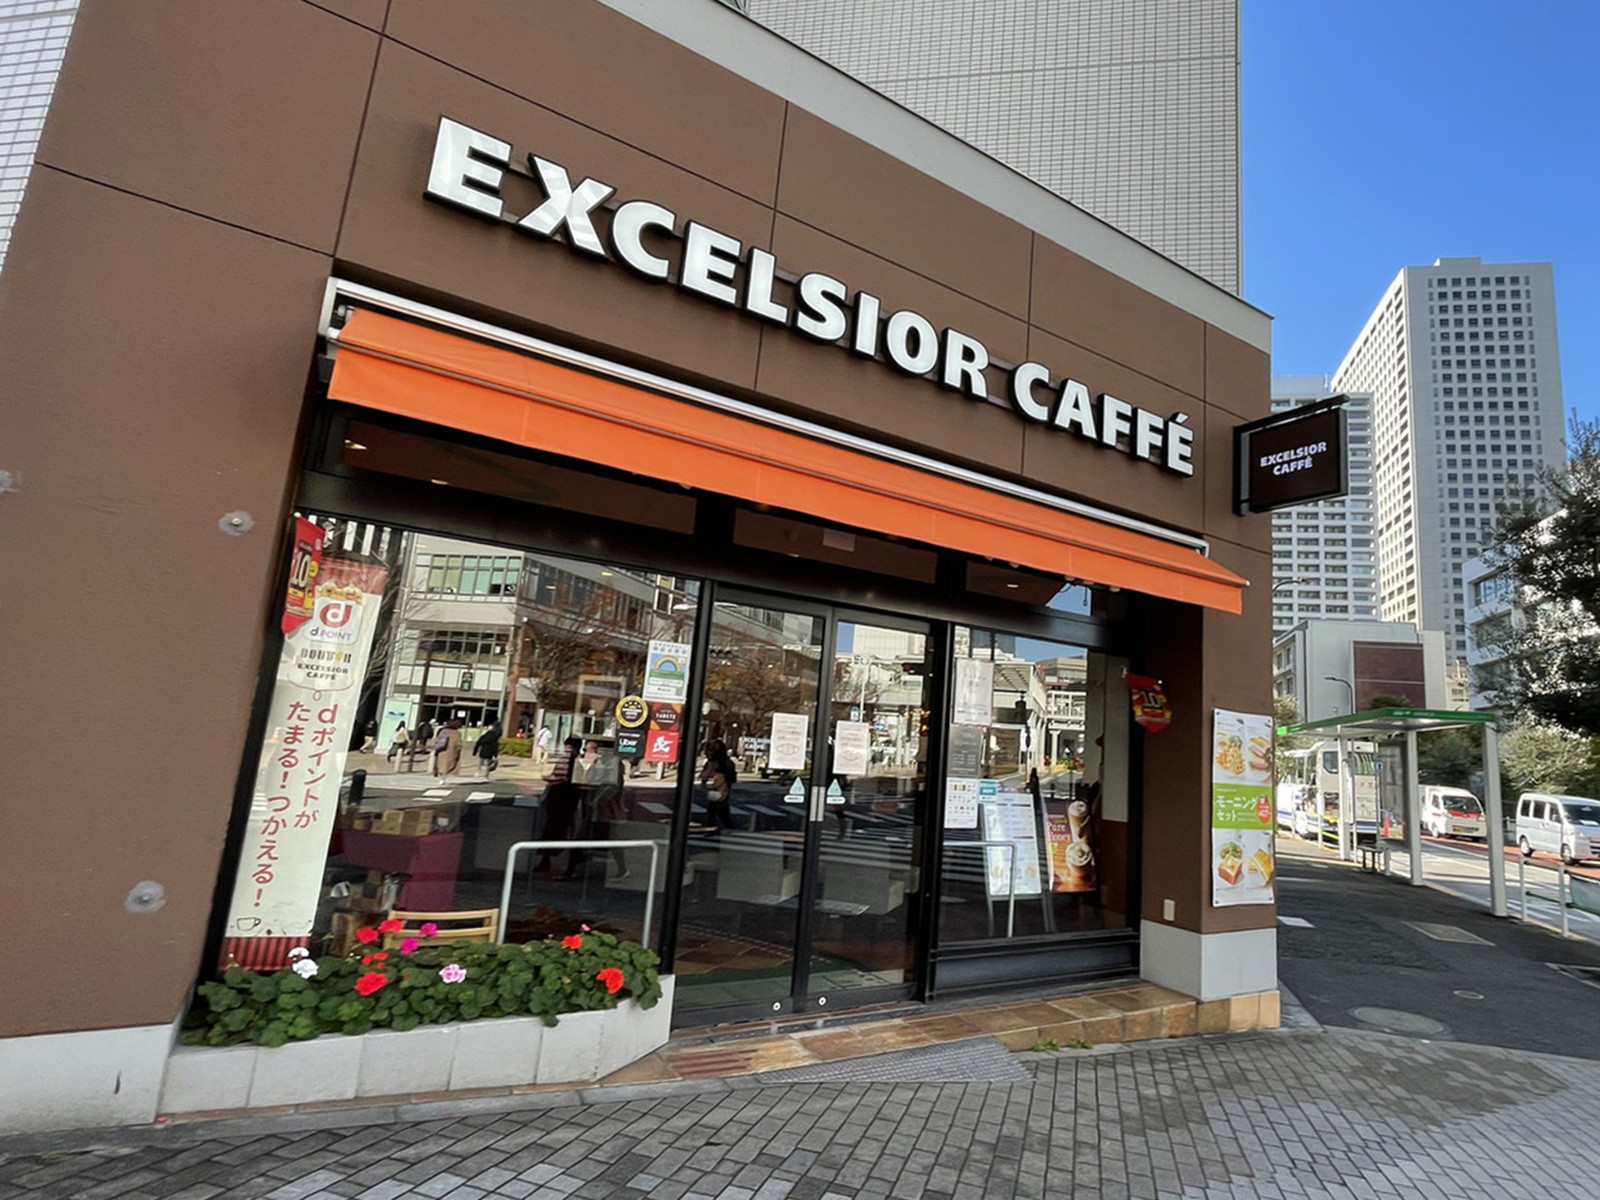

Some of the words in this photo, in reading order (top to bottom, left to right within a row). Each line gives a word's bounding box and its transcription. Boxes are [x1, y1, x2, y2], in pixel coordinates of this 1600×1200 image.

[425, 115, 990, 402] EXCELSIOR
[1012, 361, 1195, 477] CAFFÉ
[1260, 441, 1327, 467] EXCELSIOR
[1272, 455, 1313, 476] CAFFÉ
[320, 630, 353, 641] POINT
[300, 648, 352, 664] DOUTOR
[297, 662, 349, 675] EXCELSIOR
[293, 703, 339, 830] dポイントが
[1216, 795, 1258, 810] モーニング
[1216, 810, 1237, 822] セット
